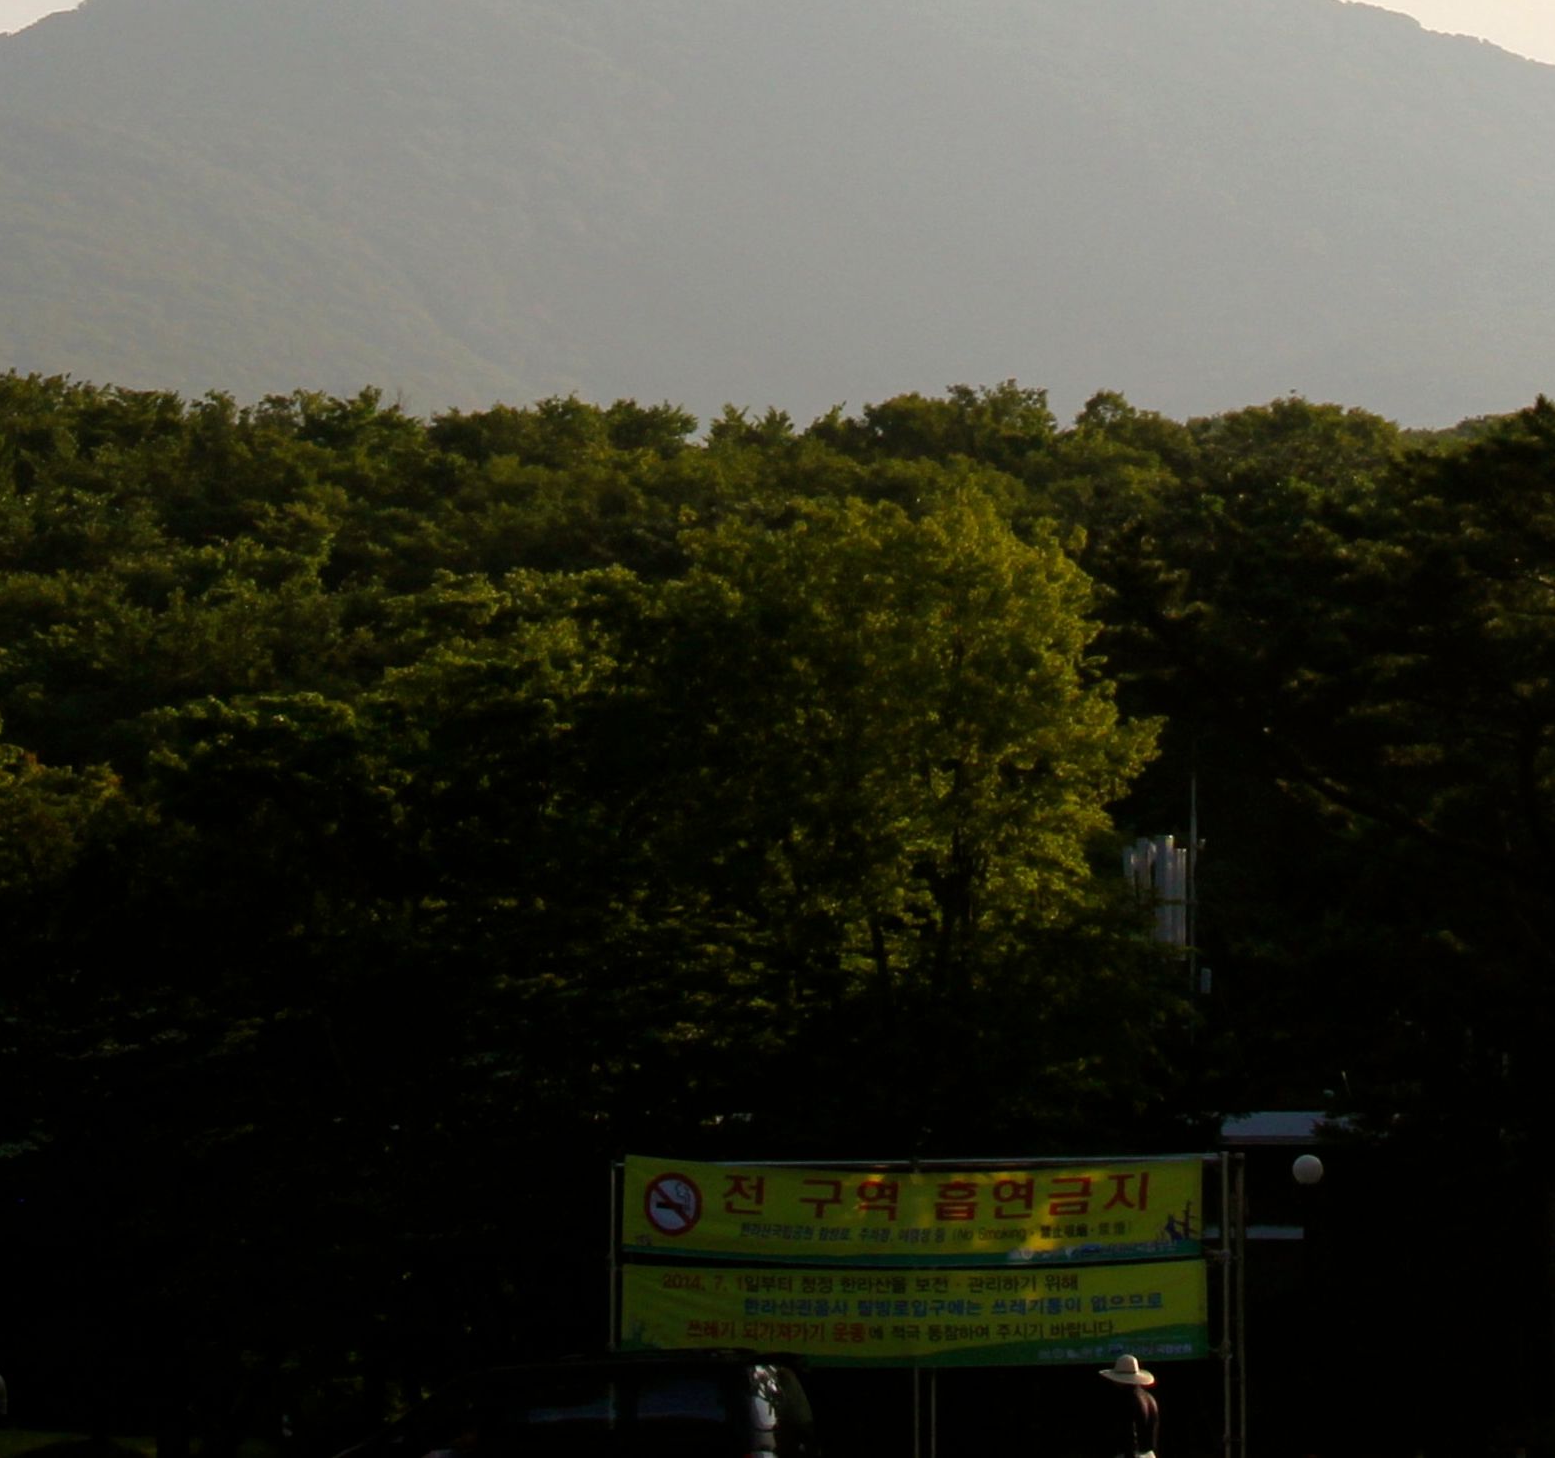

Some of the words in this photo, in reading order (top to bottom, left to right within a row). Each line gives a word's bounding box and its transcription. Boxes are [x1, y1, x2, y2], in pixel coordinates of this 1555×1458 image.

[723, 1174, 765, 1215] 전
[800, 1179, 899, 1221] 구역
[934, 1172, 1150, 1221] 흡연금지
[662, 1273, 706, 1292] 2014.
[802, 1275, 833, 1294] 청정
[840, 1275, 907, 1294] 한라산을
[915, 1275, 948, 1293] 보전
[967, 1274, 1037, 1293] 관리하기
[1044, 1273, 1078, 1292] 위해
[991, 1295, 1081, 1316] 쓰레기통이
[1091, 1292, 1163, 1313] 없으므로
[687, 1320, 736, 1340] 쓰레기
[890, 1323, 920, 1342] 적극
[928, 1323, 989, 1342] 동참하여
[997, 1321, 1044, 1340] 주시기
